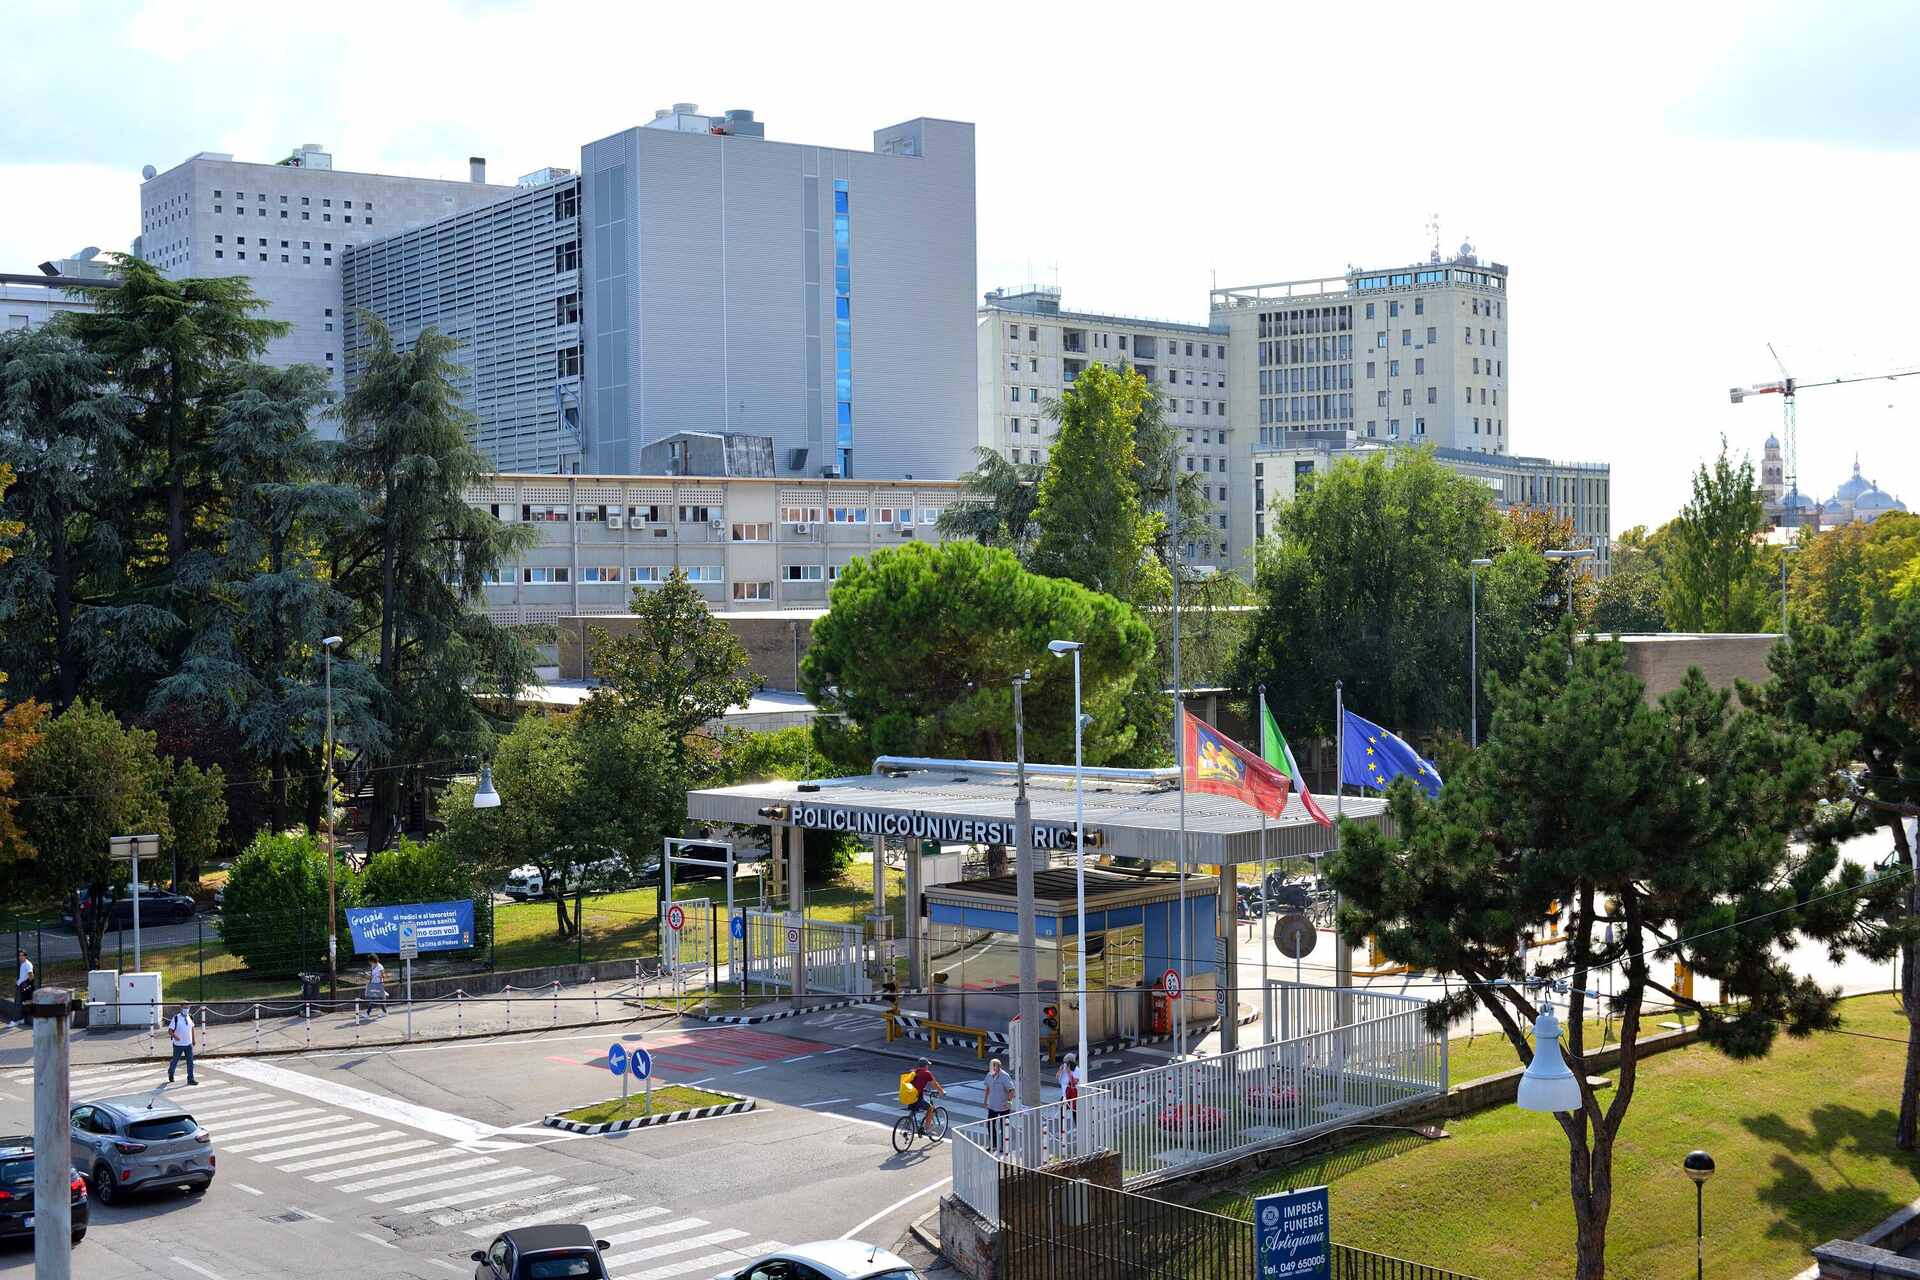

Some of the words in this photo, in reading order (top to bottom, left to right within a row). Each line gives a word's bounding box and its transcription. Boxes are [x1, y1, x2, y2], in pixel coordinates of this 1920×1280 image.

[351, 910, 384, 926] Grazie
[400, 912, 418, 920] medici
[429, 910, 457, 919] lavoratori
[363, 921, 398, 939] infinite
[443, 926, 457, 934] voi!
[1283, 1200, 1323, 1218] IMPRESA
[1284, 1214, 1324, 1232] FUNEBRE
[1260, 1229, 1325, 1256] Artigiana
[1263, 1264, 1278, 1275] Tel.
[1280, 1260, 1296, 1272] 049
[1297, 1254, 1326, 1269] 650005
